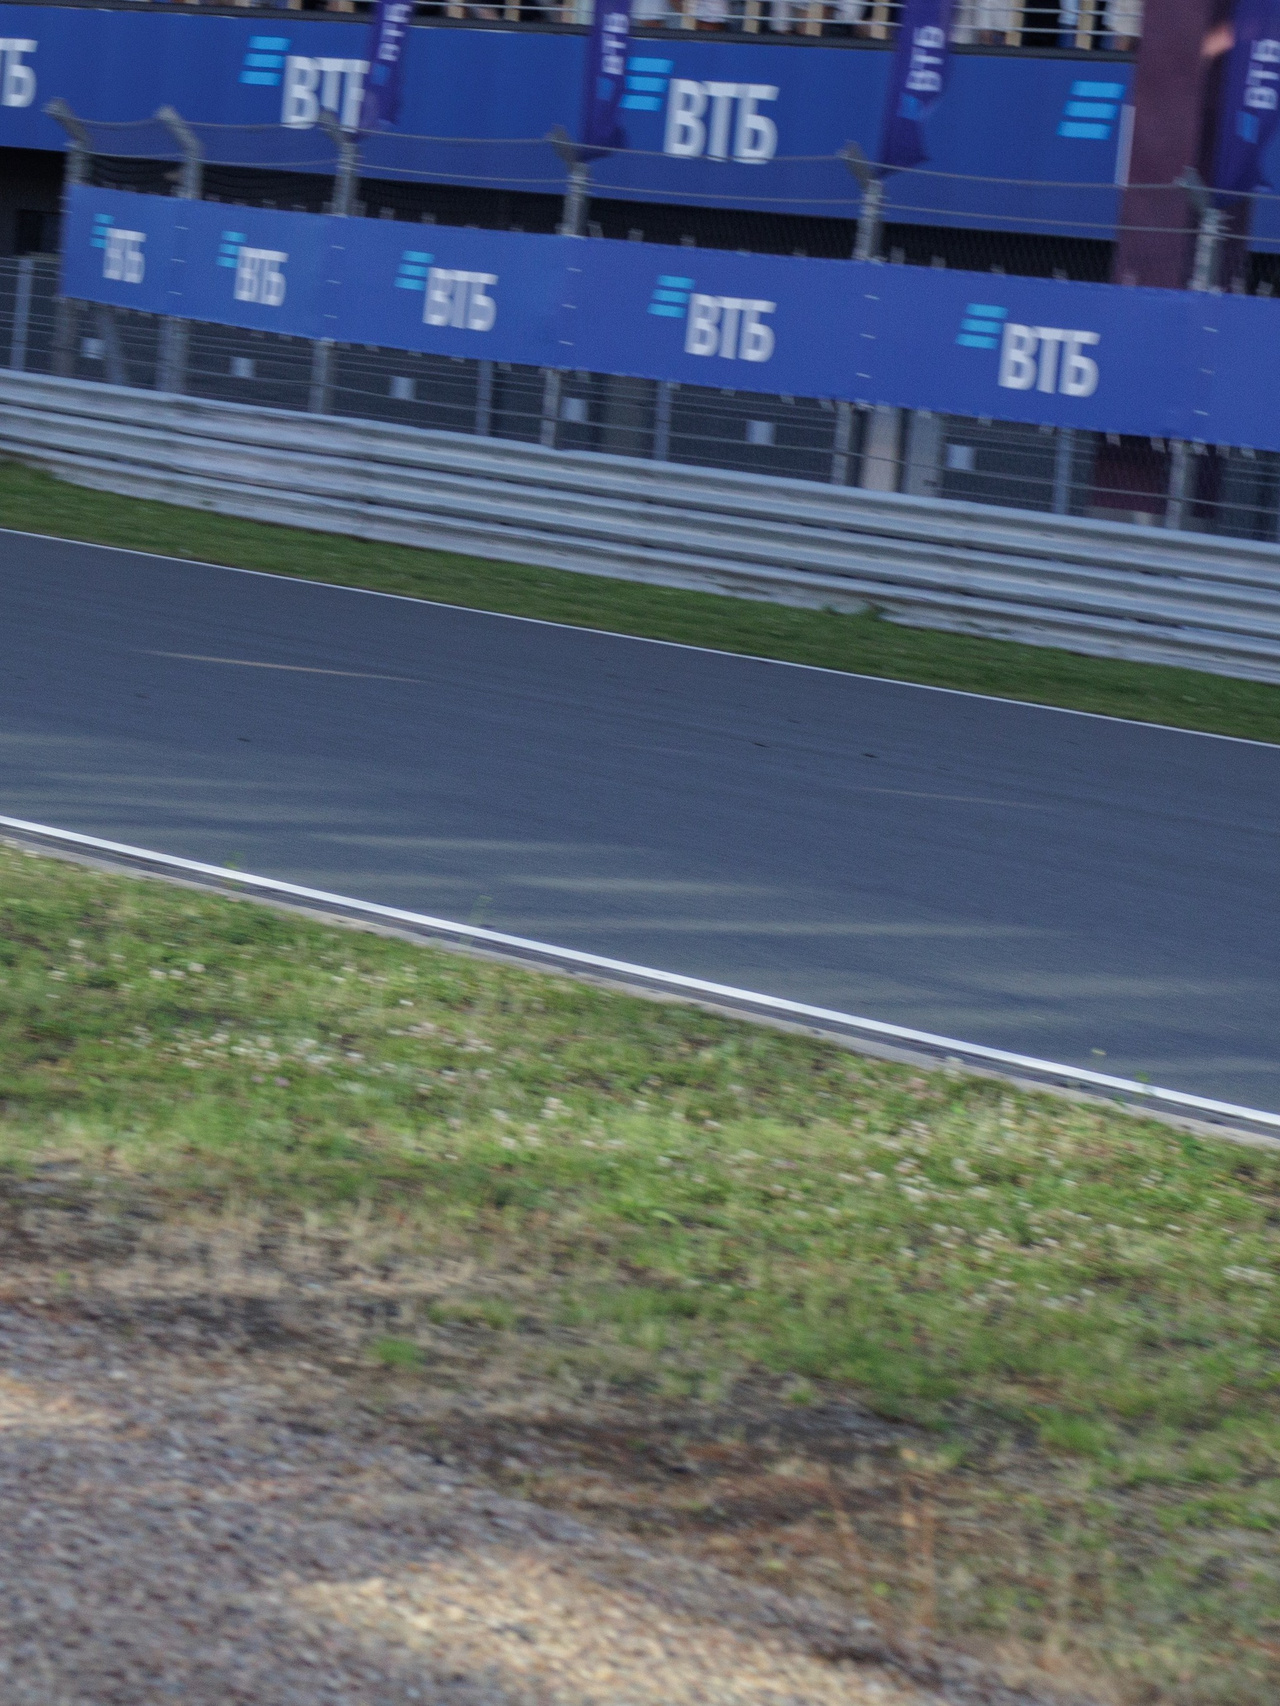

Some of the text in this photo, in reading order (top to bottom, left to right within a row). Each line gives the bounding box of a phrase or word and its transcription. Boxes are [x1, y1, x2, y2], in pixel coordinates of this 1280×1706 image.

[663, 78, 780, 165] ВТБ
[233, 246, 288, 307] ВТБ
[423, 267, 498, 332] ВТБ
[684, 292, 777, 363] ВТБ
[998, 322, 1101, 398] ВТБ
